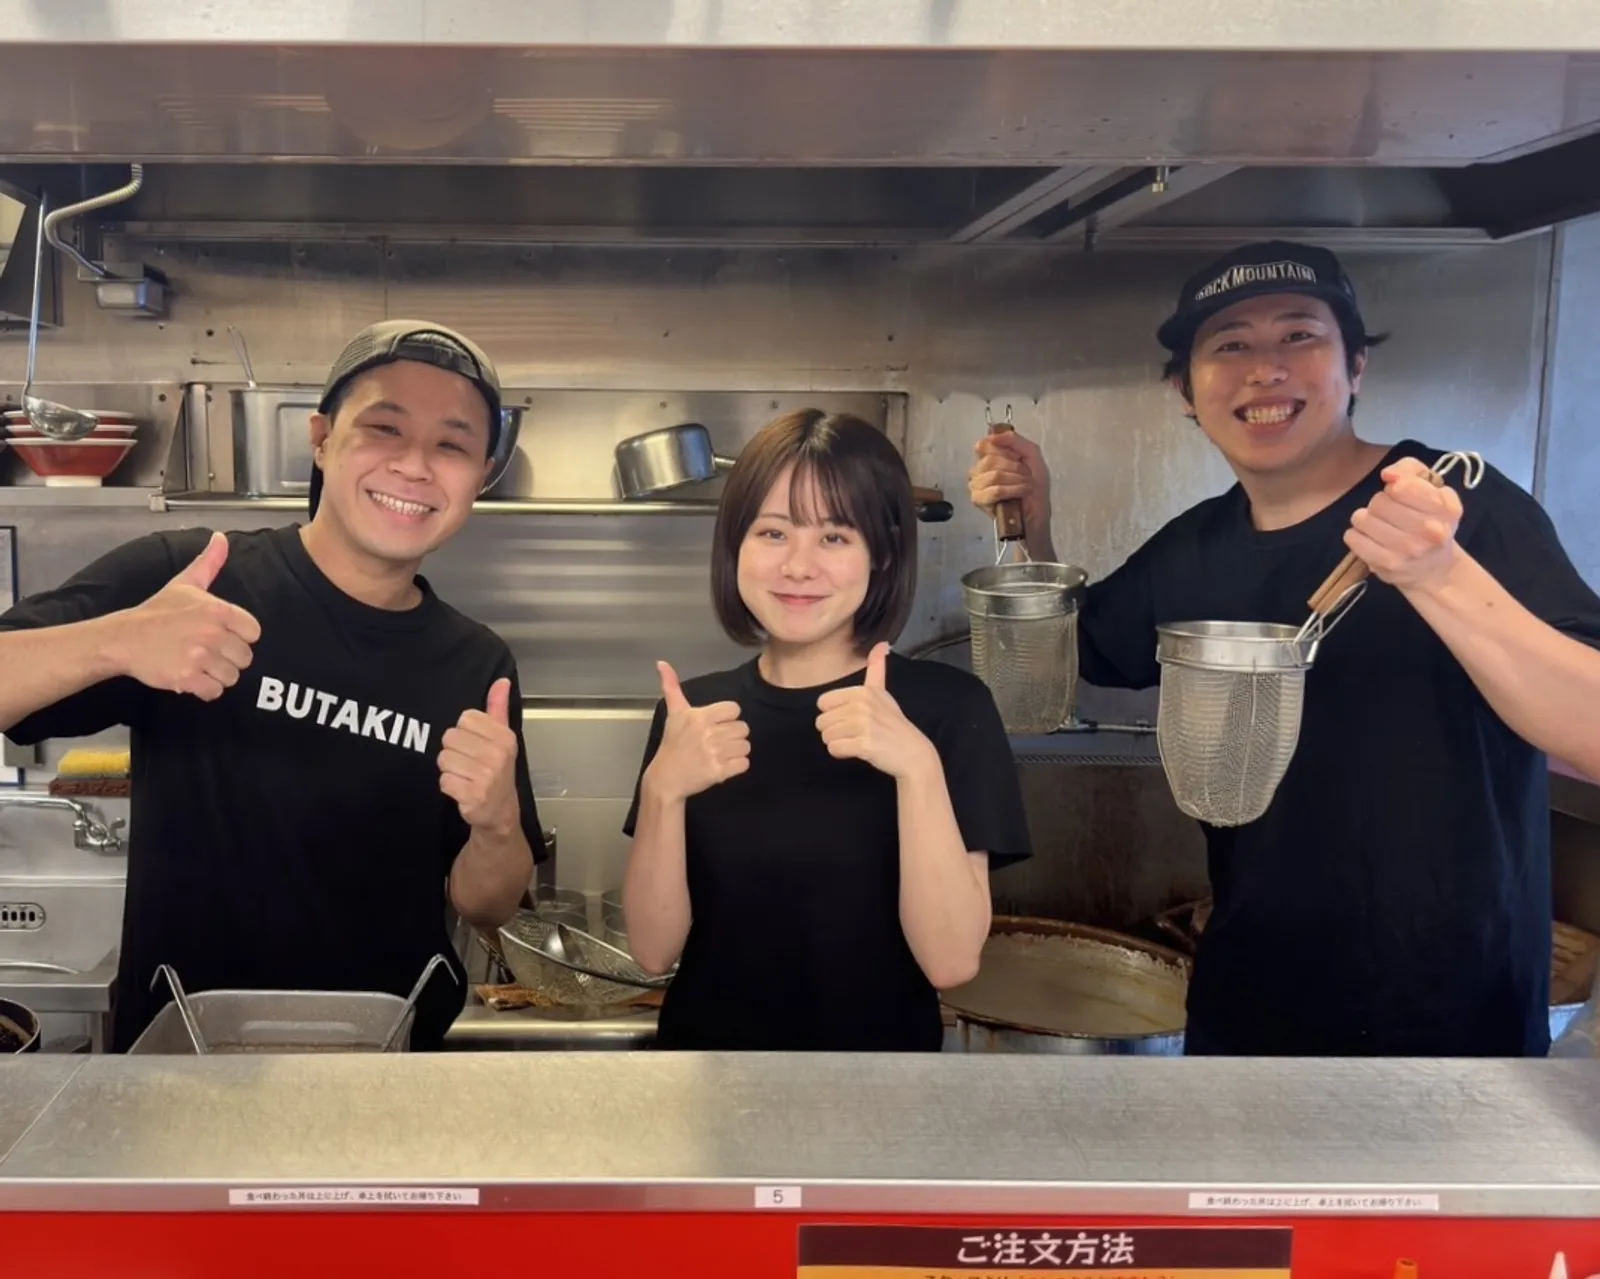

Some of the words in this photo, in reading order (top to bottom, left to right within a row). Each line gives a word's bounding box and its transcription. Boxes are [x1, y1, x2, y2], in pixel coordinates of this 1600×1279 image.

[256, 675, 431, 754] BUTAKIN
[773, 1189, 783, 1204] 5
[957, 1231, 1135, 1265] ご注文方法
